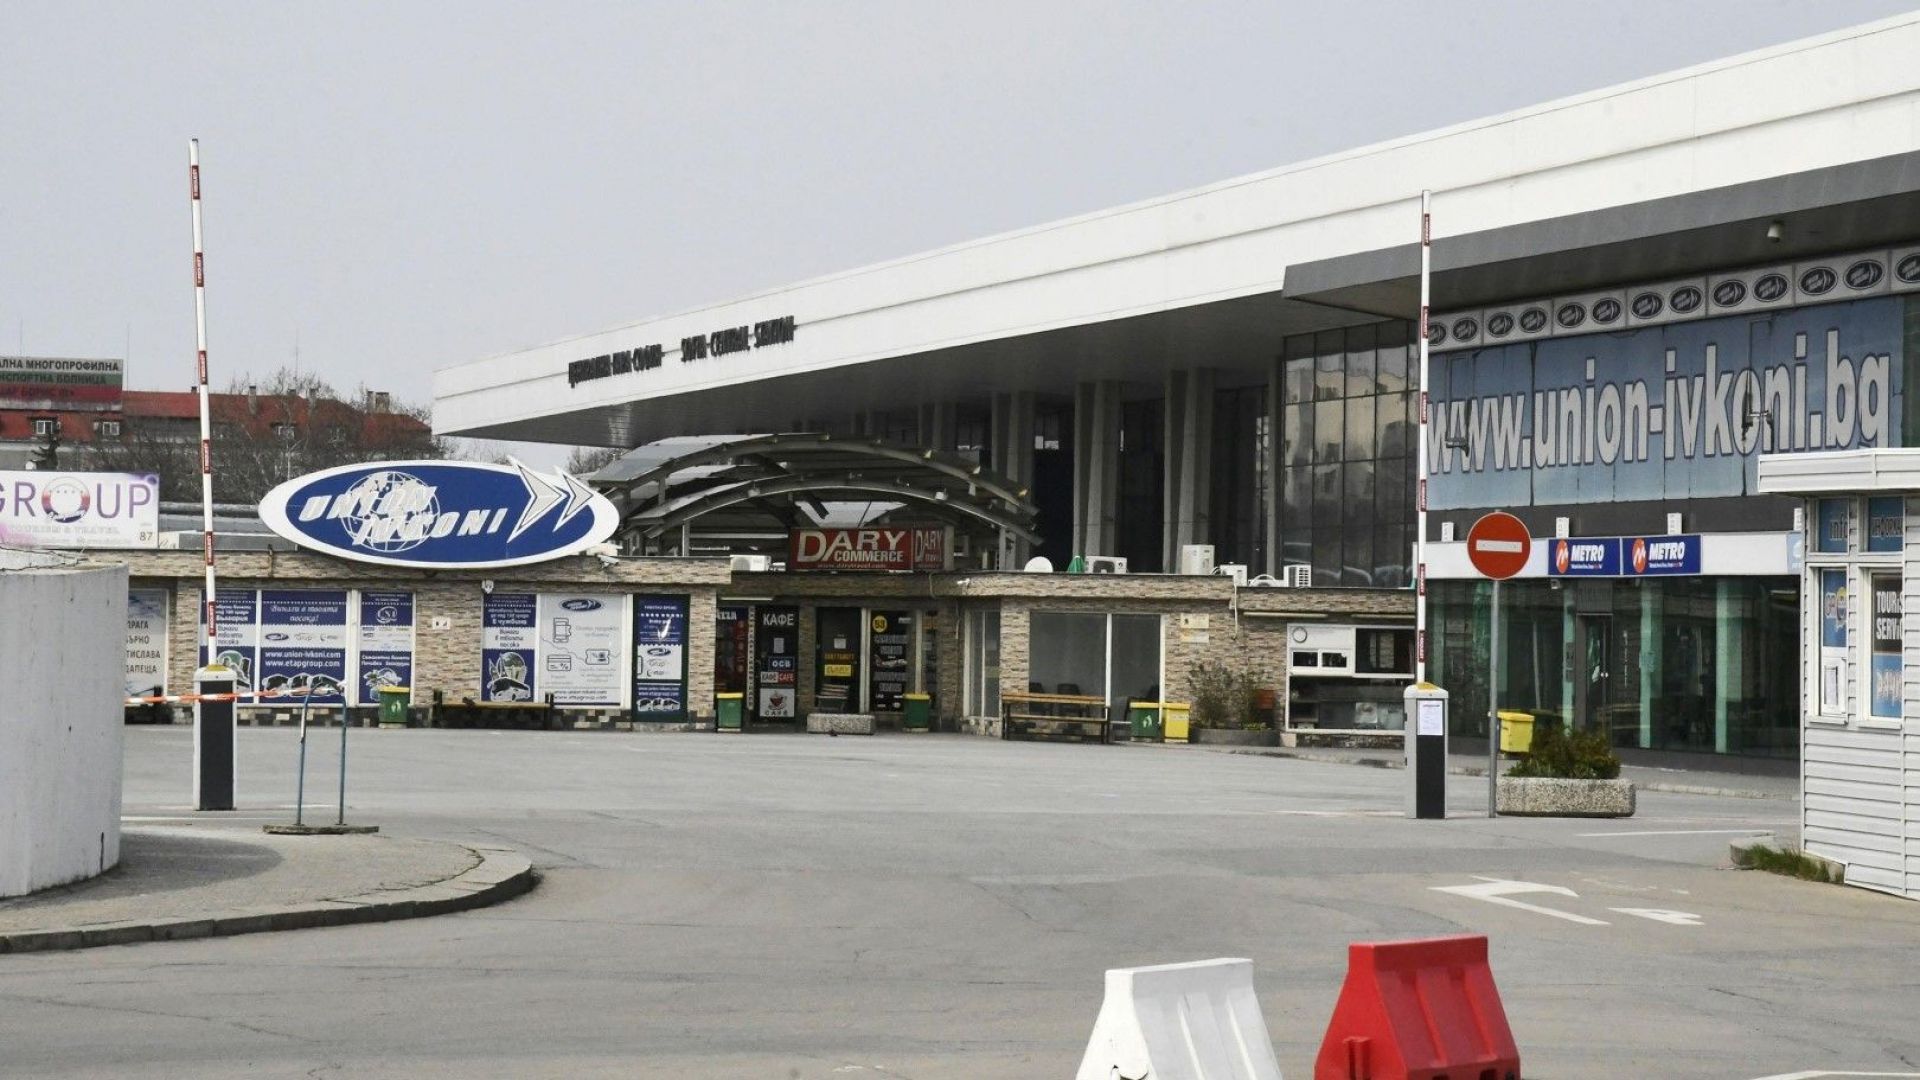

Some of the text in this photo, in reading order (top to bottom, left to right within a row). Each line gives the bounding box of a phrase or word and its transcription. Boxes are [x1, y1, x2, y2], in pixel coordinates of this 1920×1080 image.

[26, 360, 119, 371] МНОГОПРОФИЛНА
[1427, 328, 1890, 474] www.union-ivkoni.bg
[0, 477, 151, 522] ROUP
[797, 531, 906, 562] DARY
[915, 530, 943, 562] DARY
[1571, 544, 1605, 561] METRO
[1649, 542, 1681, 560] METRO
[834, 551, 903, 562] COMMERCE
[763, 613, 795, 626] КАФЕ
[265, 650, 341, 658] www.union-ivkoni.com
[265, 660, 340, 668] www.etapgroup.com
